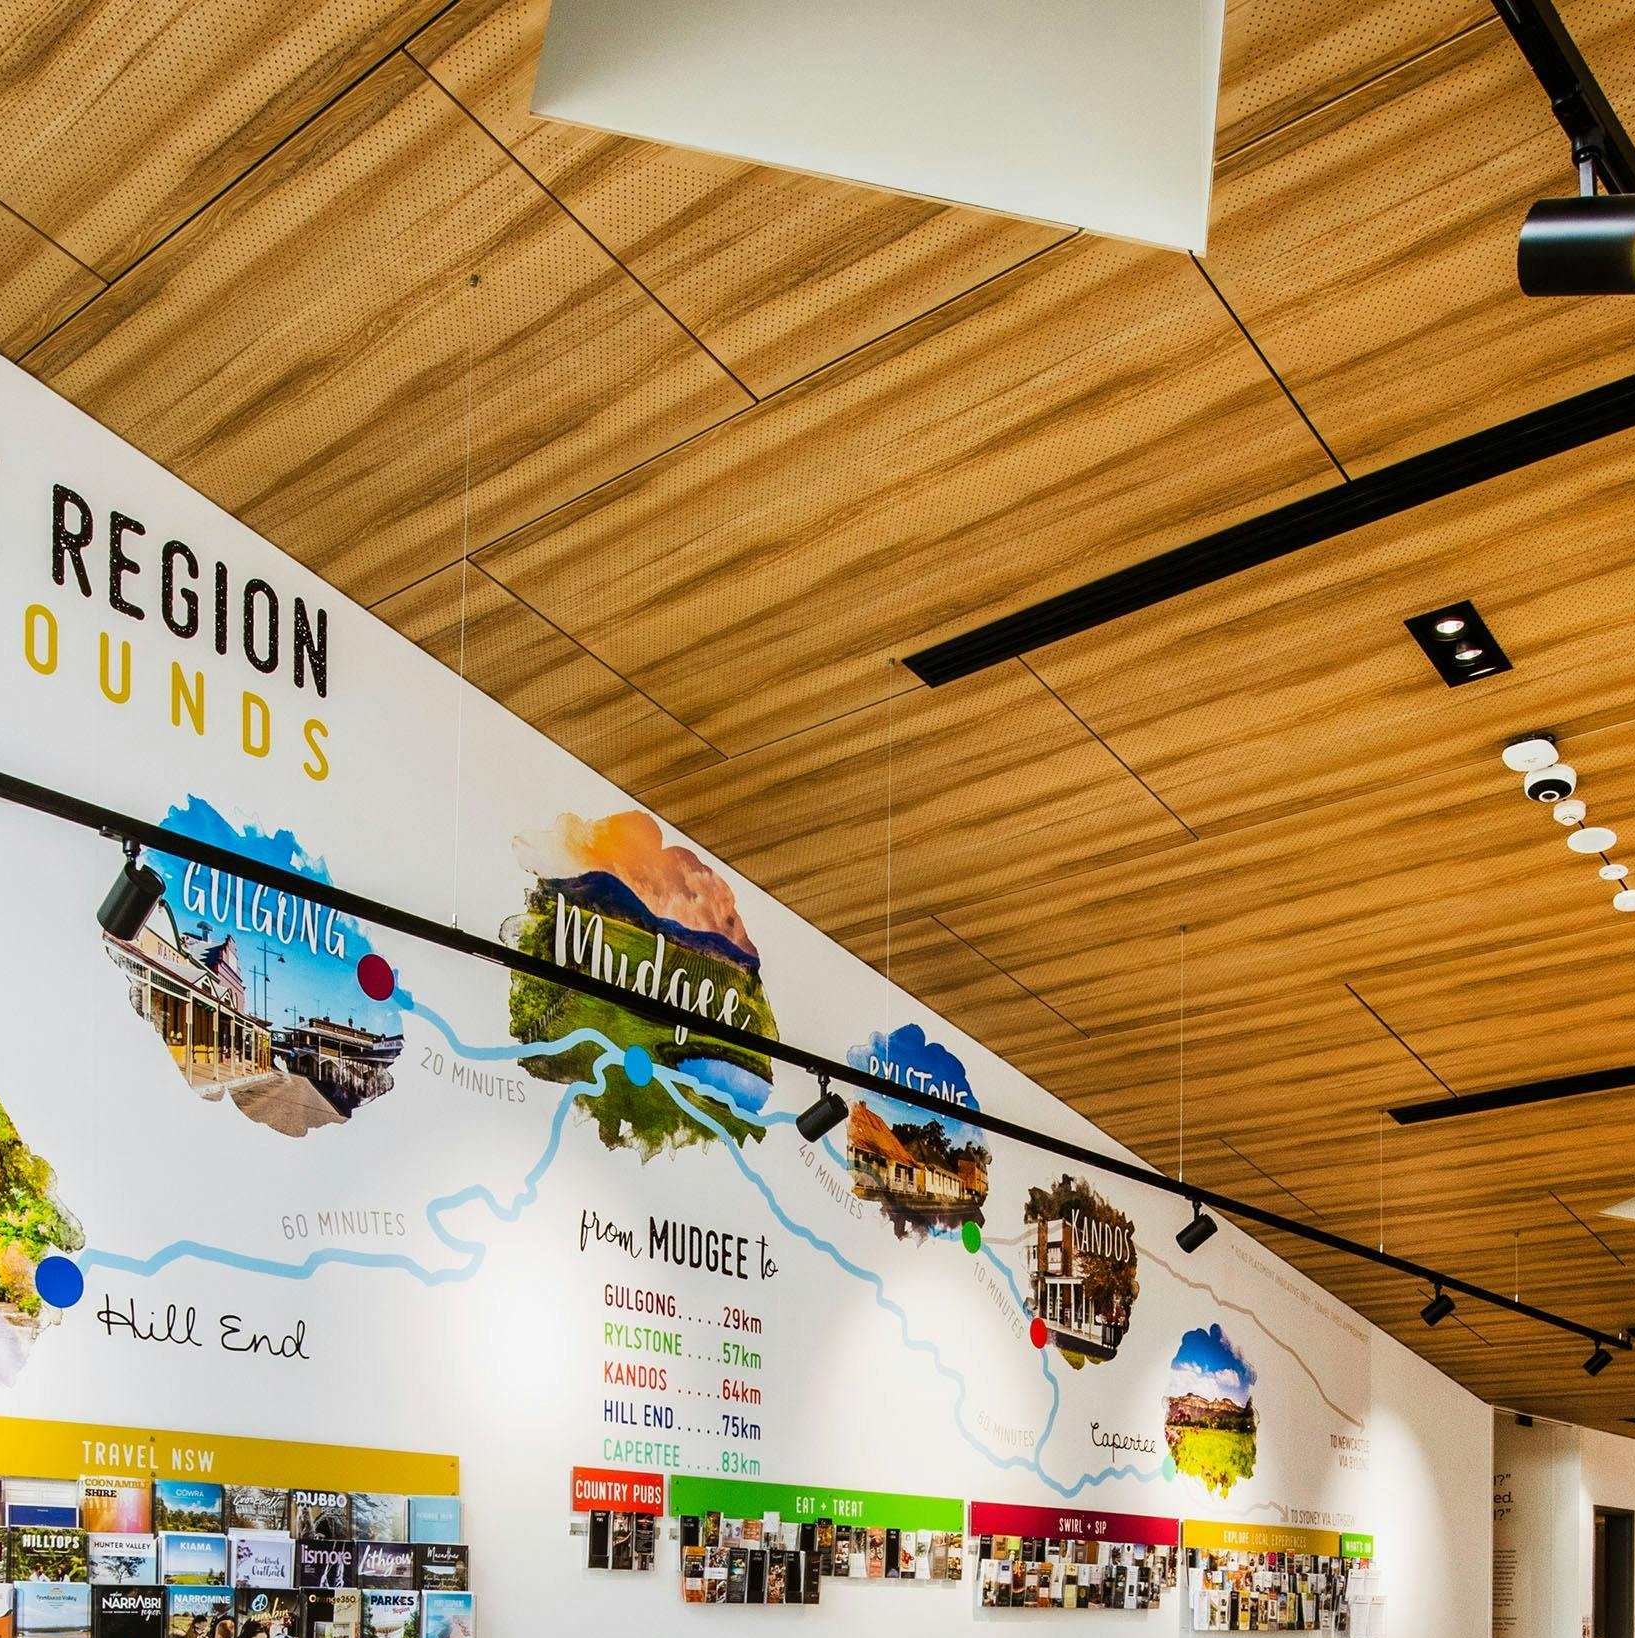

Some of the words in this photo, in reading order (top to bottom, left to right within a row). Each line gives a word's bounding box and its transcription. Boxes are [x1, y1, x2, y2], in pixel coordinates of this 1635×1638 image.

[53, 483, 328, 699] REGION
[183, 861, 346, 961] GULGONG
[555, 892, 752, 1046] Mudgee
[420, 1047, 444, 1076] 20
[452, 1059, 526, 1104] MINUTES
[799, 1143, 813, 1166] 40
[816, 1168, 864, 1221] MINUTES
[281, 1215, 309, 1240] 60
[318, 1210, 406, 1237] MINUTES
[1071, 1209, 1131, 1264] KANDOS
[580, 1209, 642, 1258] from
[649, 1216, 749, 1280] MUDGEE
[756, 1235, 778, 1280] to
[604, 1284, 676, 1318] GULGONG
[723, 1306, 762, 1334] 29km
[973, 1262, 985, 1283] 10
[985, 1282, 1025, 1340] MINUTES
[97, 1293, 203, 1348] Hill
[219, 1313, 310, 1360] End
[604, 1323, 682, 1357] RYLSTONE
[722, 1343, 762, 1370] 57km
[604, 1361, 667, 1391] KANDOS
[722, 1379, 762, 1405] 64km
[604, 1401, 638, 1425] HILL
[644, 1404, 674, 1431] END
[722, 1415, 762, 1441] 75km
[993, 1422, 1035, 1448] MINUTES
[82, 1440, 159, 1470] TRAVEL
[171, 1449, 214, 1473] NSW
[1090, 1421, 1156, 1462] Capertee
[603, 1439, 681, 1468] CAPERTEE
[722, 1452, 761, 1477] 83km
[85, 1489, 117, 1498] SHIRE
[176, 1489, 204, 1498] COWRA
[575, 1480, 628, 1502] COUNTRY
[633, 1486, 662, 1504] PUBS
[796, 1496, 816, 1513] EAT
[833, 1499, 863, 1518] TREAT
[1059, 1517, 1083, 1533] SWIRL
[1095, 1520, 1107, 1534] SIP
[1291, 1509, 1297, 1523] TO
[1297, 1510, 1321, 1524] SYDNEY
[1322, 1512, 1332, 1524] VIA
[22, 1534, 79, 1549] HILLTOPS
[94, 1541, 123, 1549] HUNTER
[126, 1542, 151, 1550] VALLEY
[180, 1542, 212, 1552] KIAMA
[301, 1544, 352, 1565] lismore
[1224, 1531, 1249, 1544] EXPLORE
[1252, 1532, 1268, 1545] LOCAL
[1271, 1534, 1306, 1548] EXPERIENCES
[358, 1545, 414, 1576] Lithgow
[102, 1595, 161, 1609] NARRABRI
[174, 1594, 231, 1604] NARROMINE
[370, 1595, 414, 1606] PARKES
